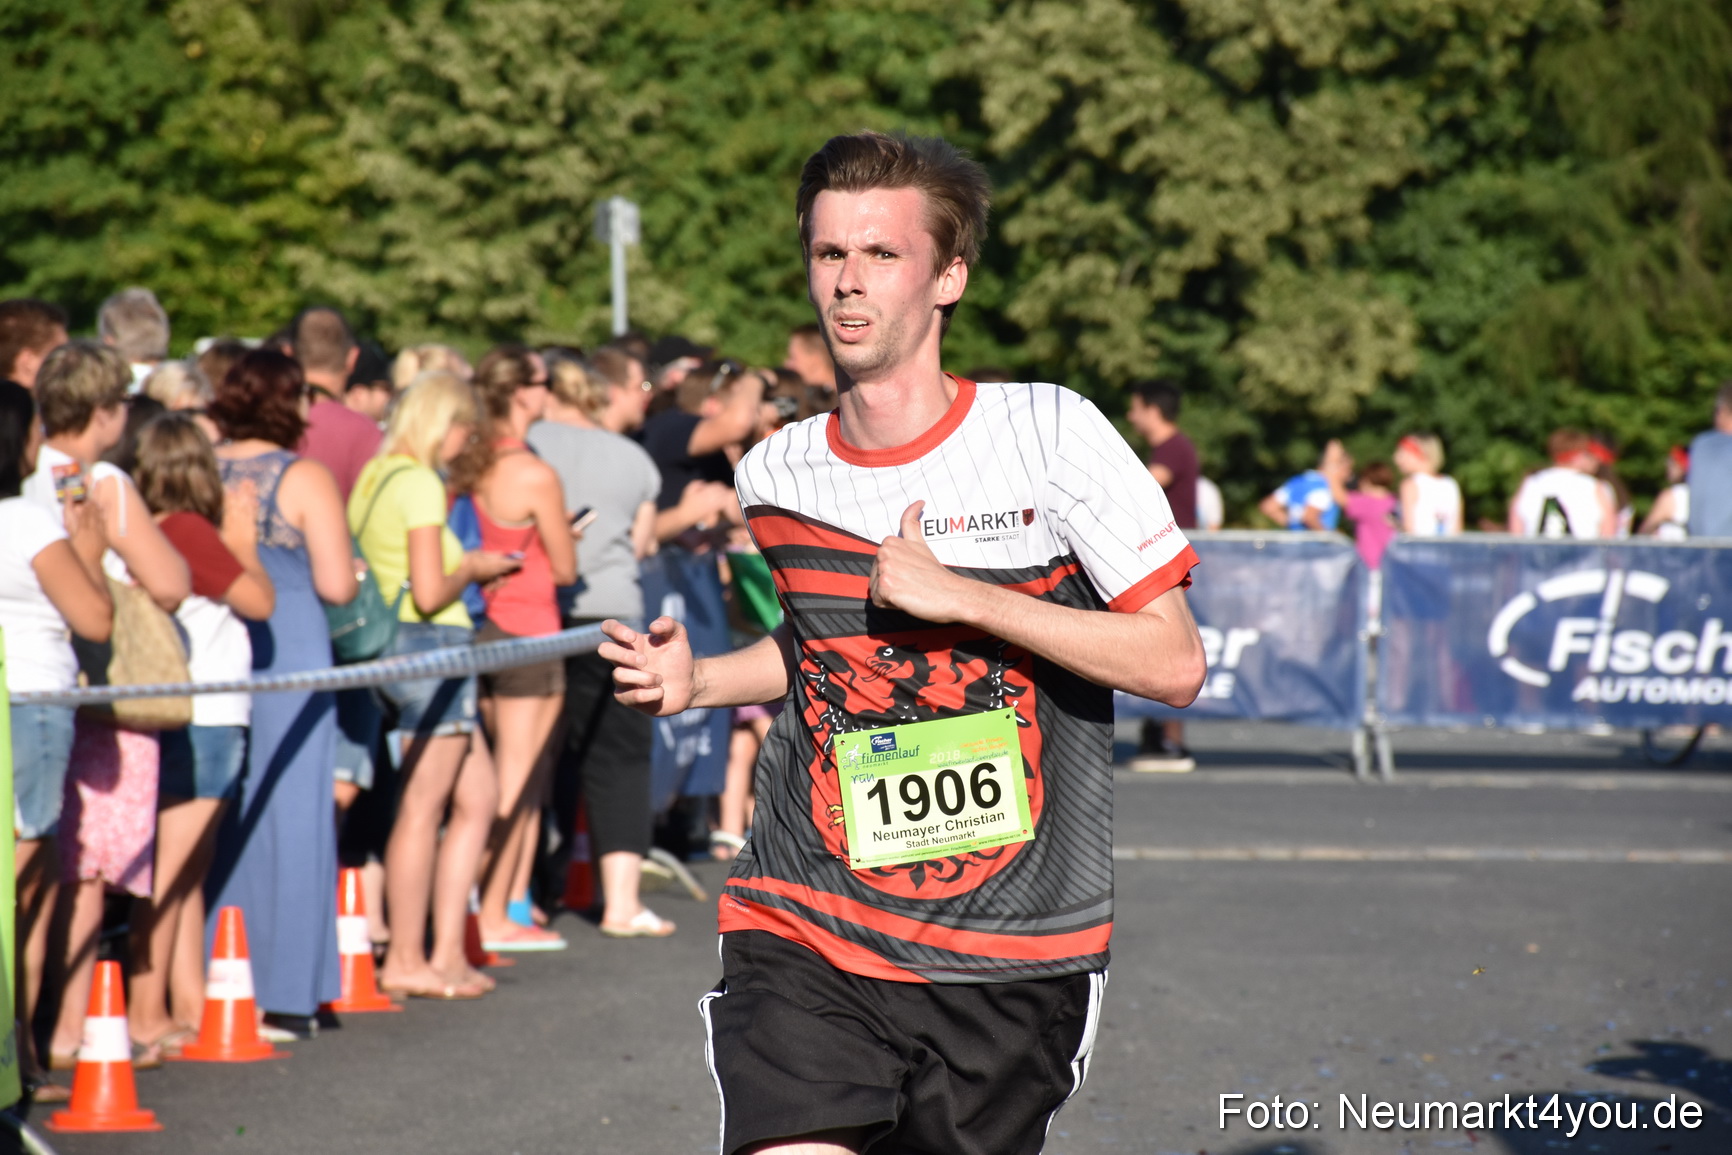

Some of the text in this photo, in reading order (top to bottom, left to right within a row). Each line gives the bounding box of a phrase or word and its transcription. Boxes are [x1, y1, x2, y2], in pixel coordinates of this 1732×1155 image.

[924, 510, 1019, 536] EUMARKT
[1001, 533, 1020, 541] STADT
[861, 744, 920, 765] firmenlauf
[929, 749, 960, 764] 2018
[867, 762, 1002, 825] 1906
[873, 812, 1006, 842] Neumayer Christian
[906, 839, 930, 848] Stadt
[932, 830, 976, 845] Neumarkt
